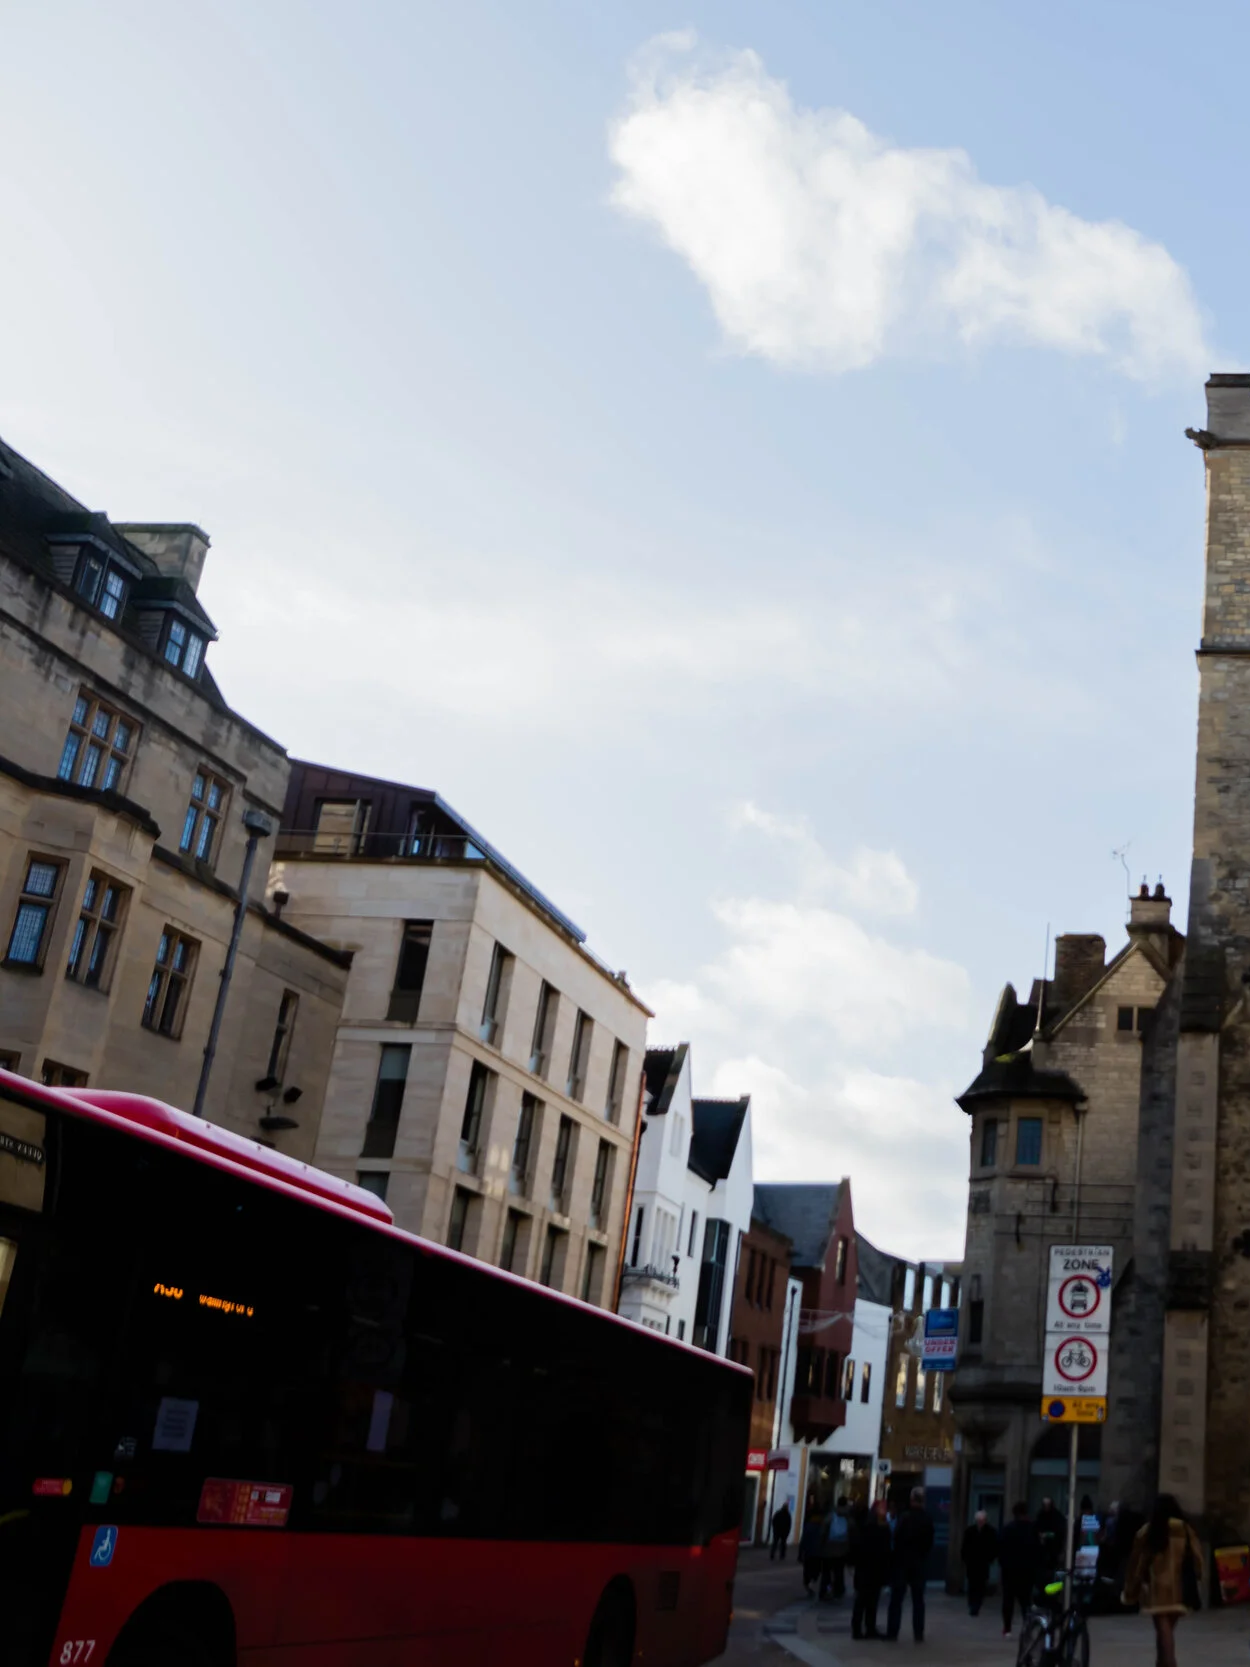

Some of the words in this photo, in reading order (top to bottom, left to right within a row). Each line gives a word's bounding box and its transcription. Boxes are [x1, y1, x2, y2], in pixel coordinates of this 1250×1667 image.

[1054, 1247, 1110, 1256] PEDESTRIAN
[1063, 1258, 1099, 1270] ZONE
[59, 1639, 96, 1665] 877
